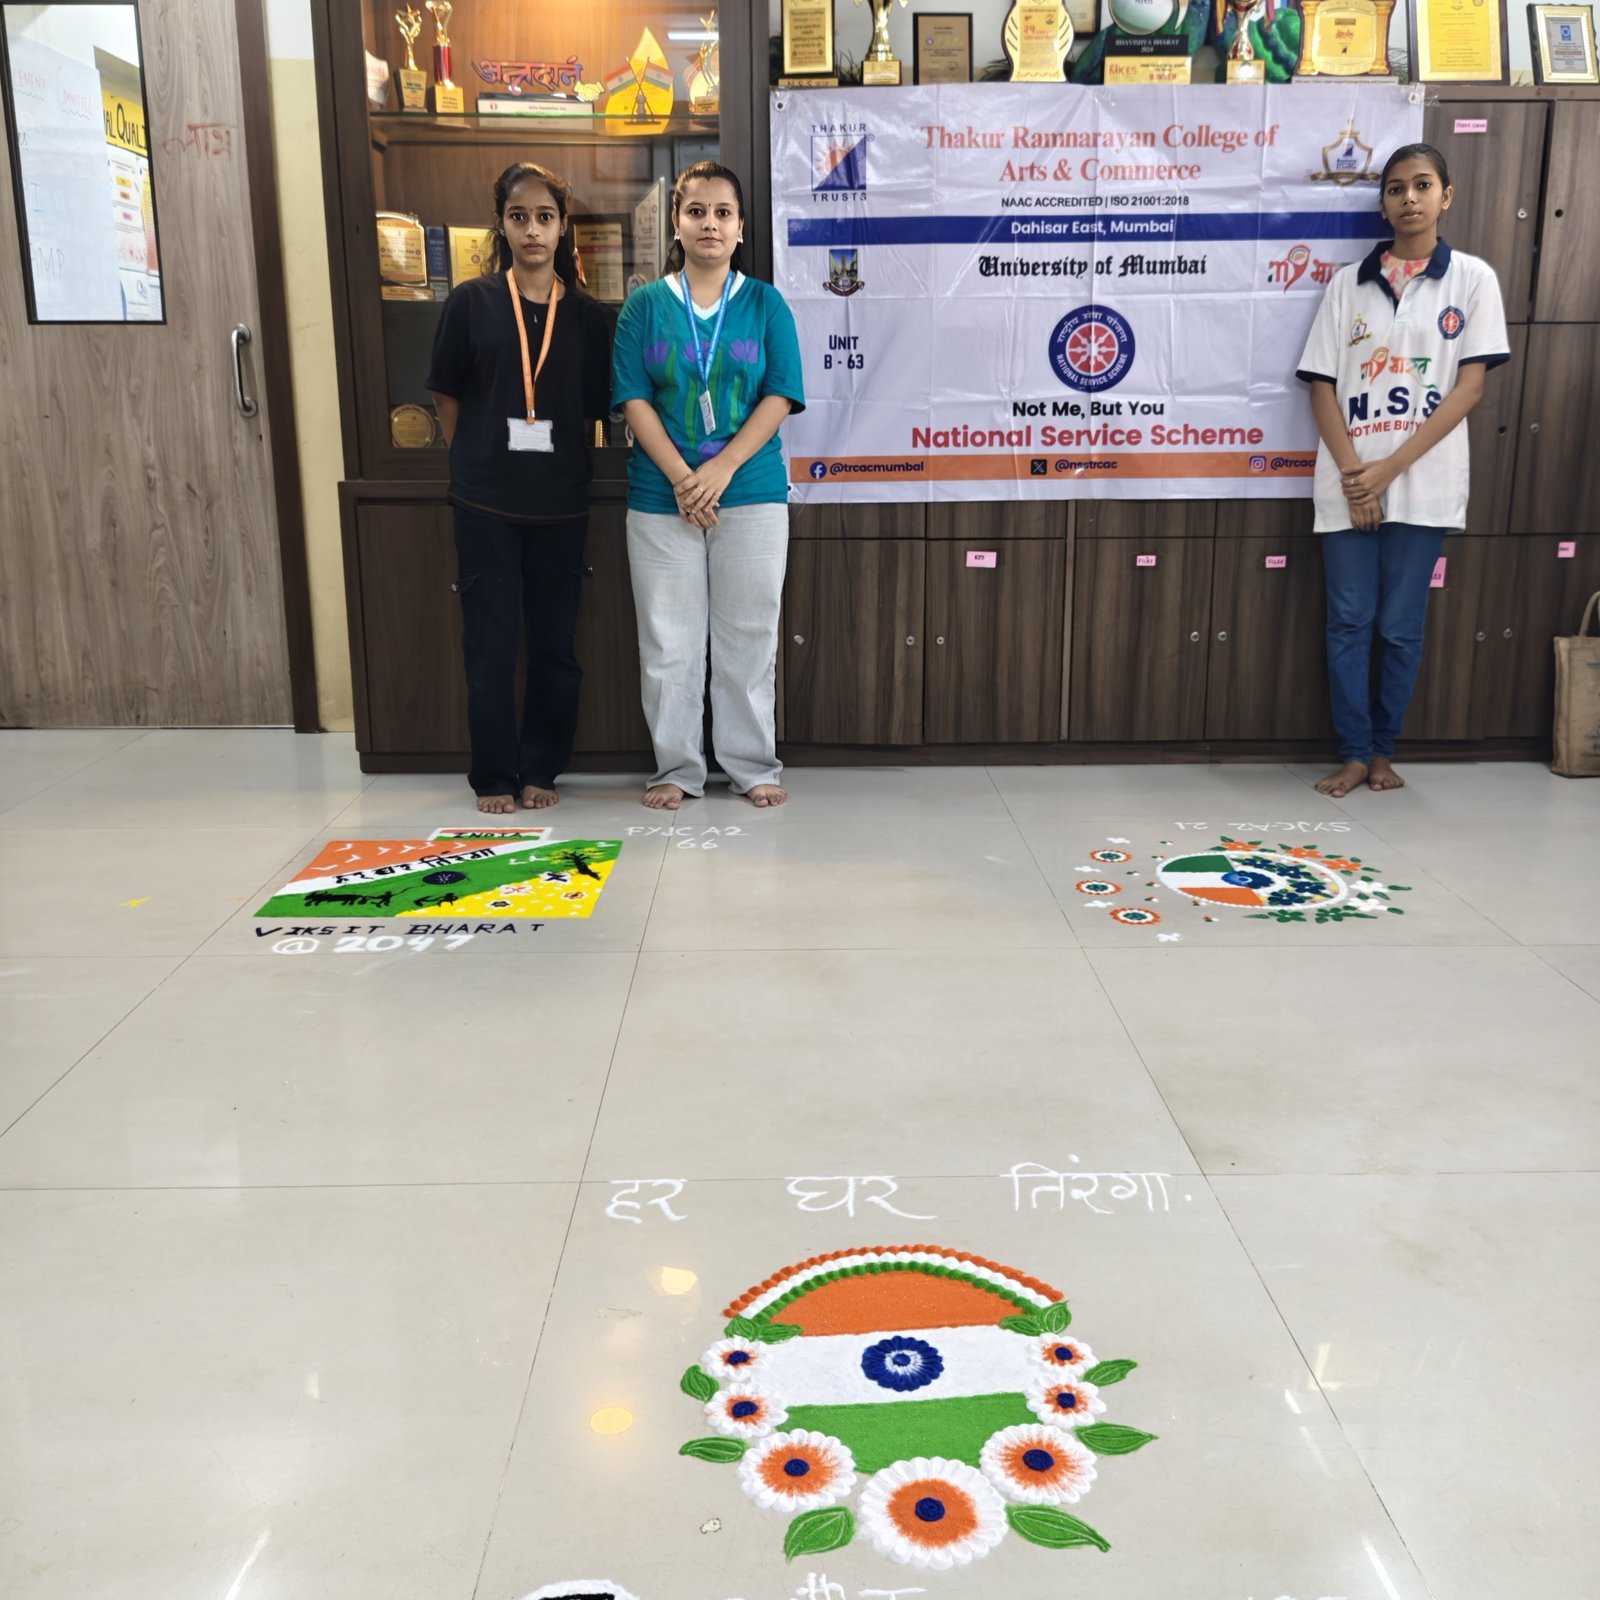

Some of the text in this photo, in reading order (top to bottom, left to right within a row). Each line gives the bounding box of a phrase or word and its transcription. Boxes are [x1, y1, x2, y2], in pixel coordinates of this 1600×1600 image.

[811, 123, 867, 134] THAKUR
[921, 124, 1280, 153] Thakur Ramnarayan College of
[999, 158, 1201, 182] Arts & Commerce
[812, 192, 868, 202] TRUSTS
[1001, 196, 1033, 207] NAAC
[1034, 196, 1103, 207] ACCREDITED
[1110, 195, 1129, 206] ISO
[1131, 195, 1189, 206] 21001:2018
[1011, 219, 1174, 236] Dahisar East, Mumbai
[979, 254, 1207, 279] University of Mumbai
[828, 335, 859, 350] UNIT
[824, 354, 832, 370] B
[847, 354, 864, 370] 63
[1056, 352, 1128, 386] NATIONAL SERVICE SCHEME
[1012, 400, 1165, 420] Not Me, But You
[912, 423, 1264, 448] National Service Scheme
[1347, 425, 1371, 438] NOT
[1372, 421, 1391, 433] ME
[1394, 420, 1414, 432] BUT
[625, 826, 751, 836] FYJC A2
[676, 838, 719, 850] 66
[255, 922, 547, 938] VIKSIT BHARAT
[272, 934, 476, 955] @ 2047
[605, 1177, 690, 1225] हर
[784, 1174, 938, 1222] घर
